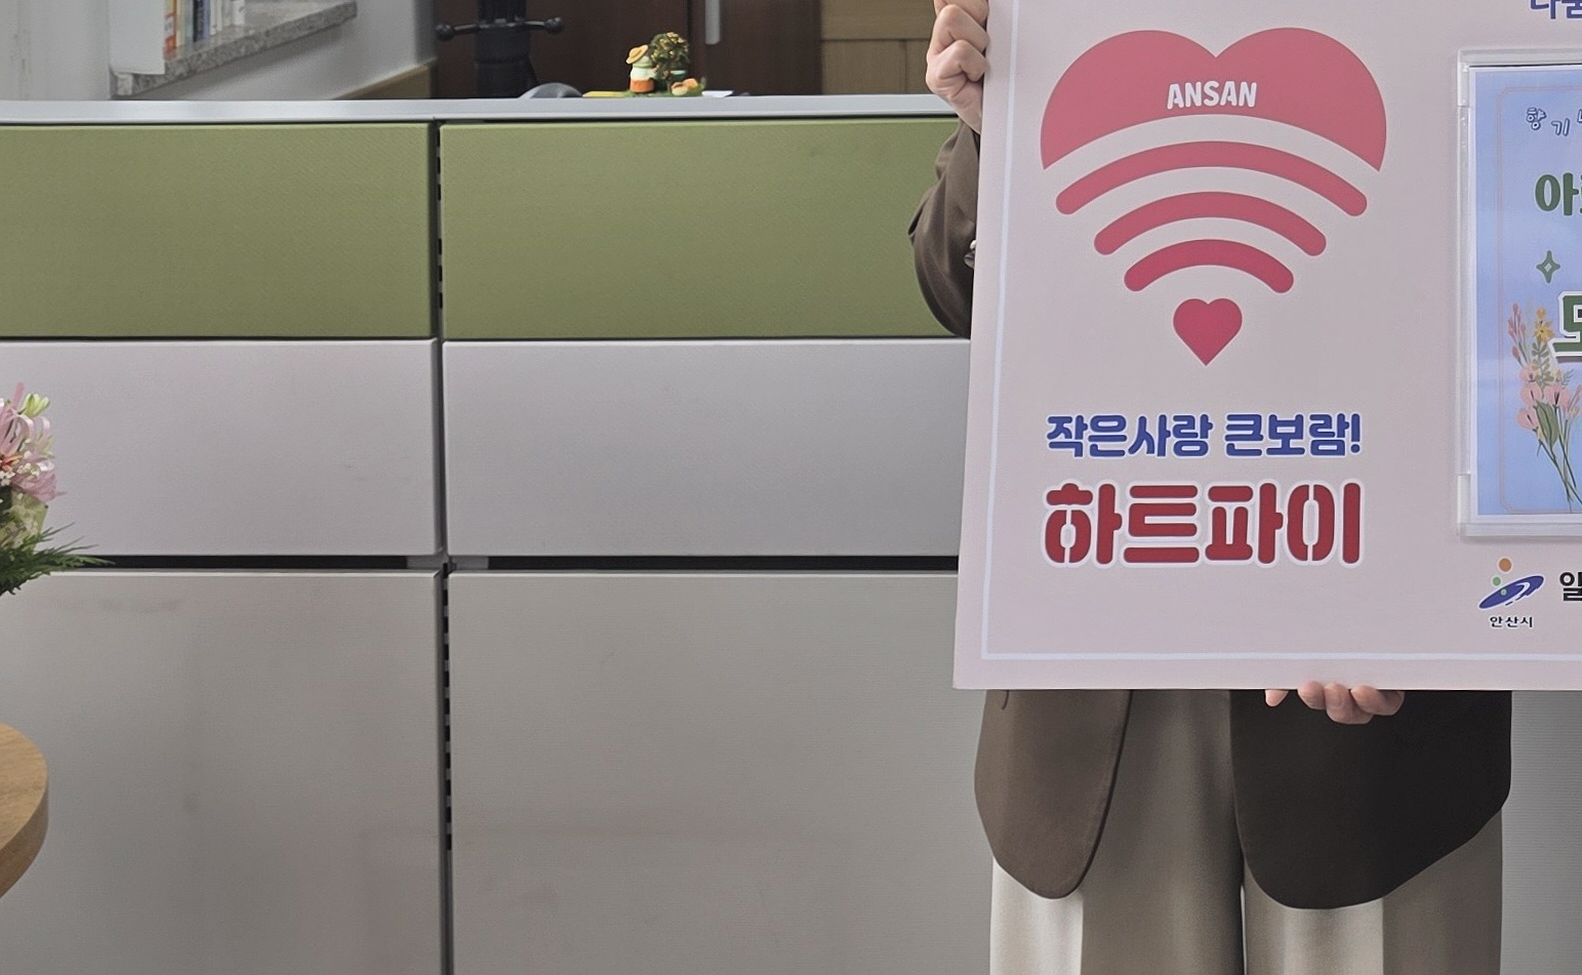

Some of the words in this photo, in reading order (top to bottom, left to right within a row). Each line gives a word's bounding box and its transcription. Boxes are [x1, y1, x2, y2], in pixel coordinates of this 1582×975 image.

[1166, 80, 1257, 109] ANSAN
[1046, 413, 1214, 458] 작은사랑
[1224, 412, 1361, 457] 큰보람!
[1044, 482, 1362, 565] 하트파이
[1489, 615, 1533, 628] 안산시
